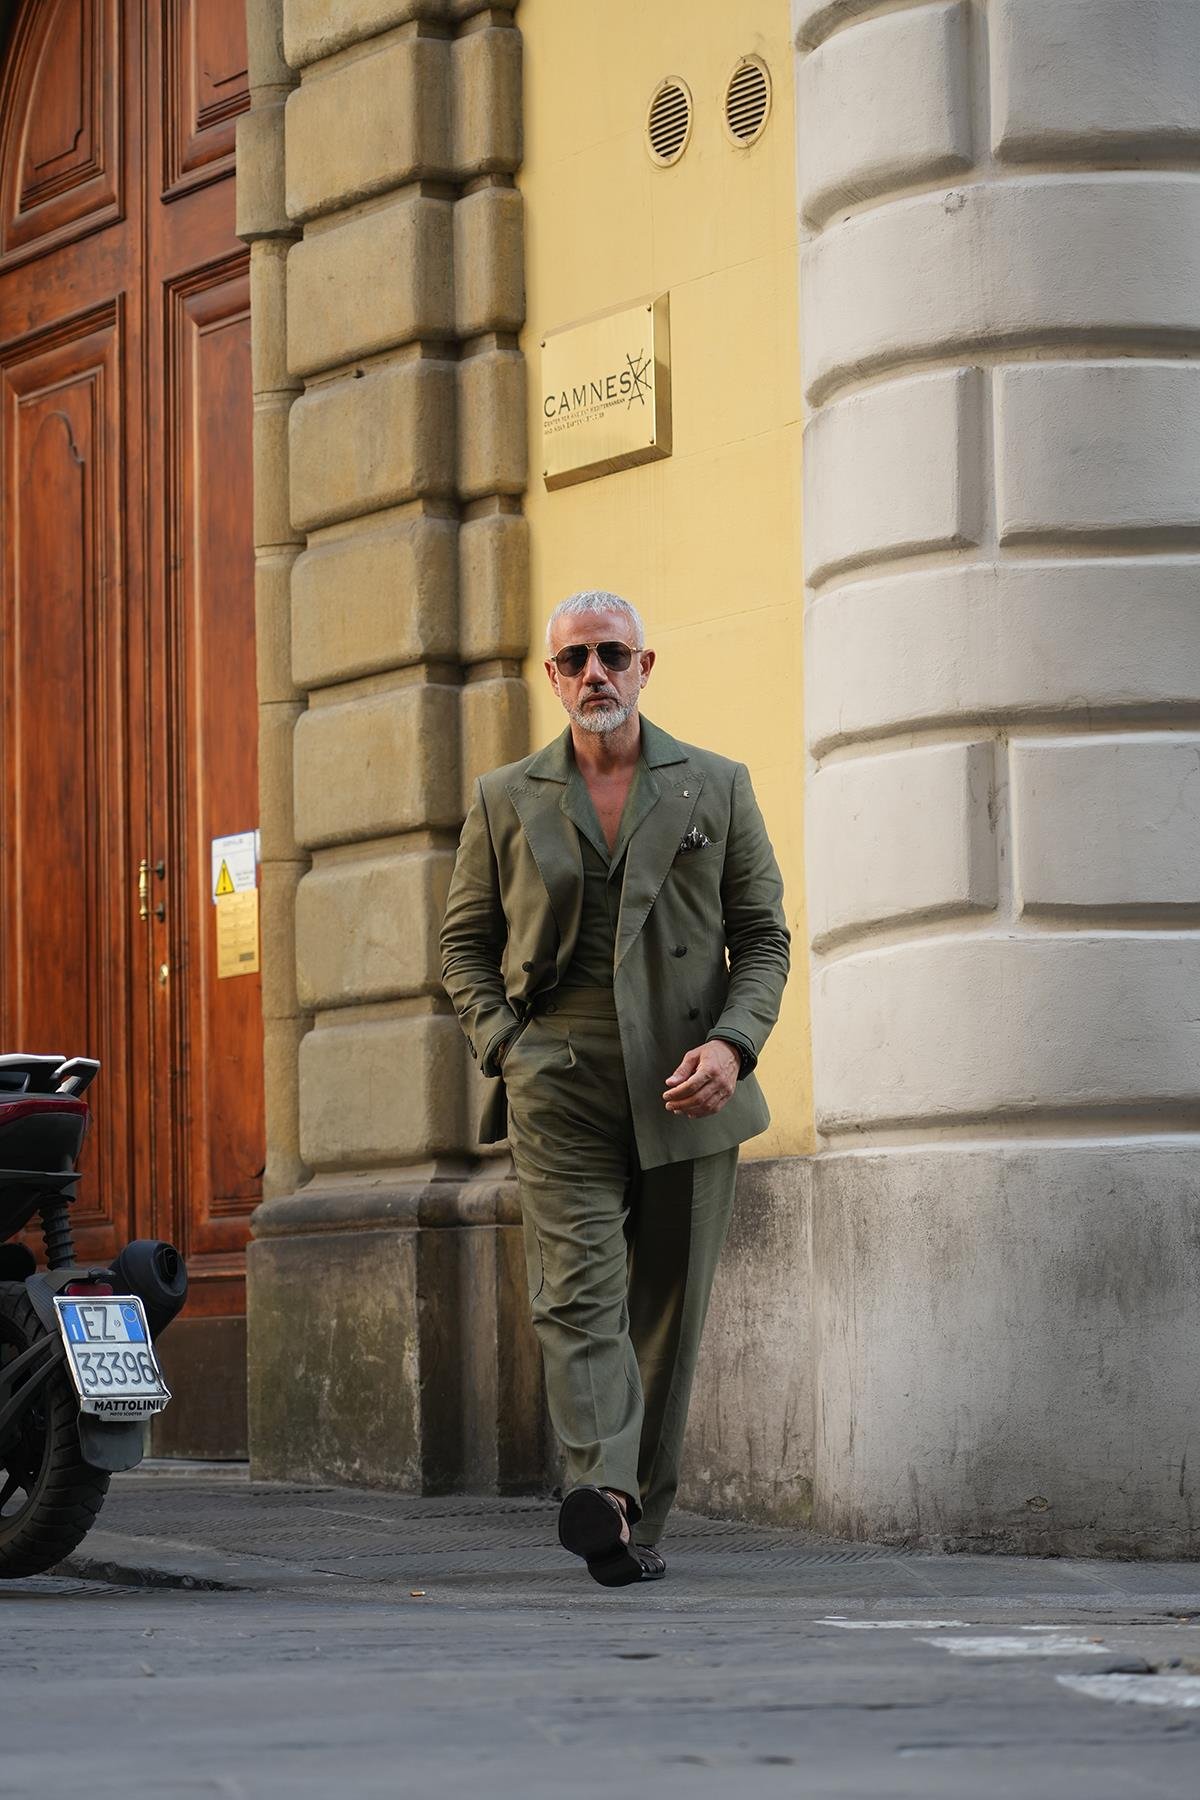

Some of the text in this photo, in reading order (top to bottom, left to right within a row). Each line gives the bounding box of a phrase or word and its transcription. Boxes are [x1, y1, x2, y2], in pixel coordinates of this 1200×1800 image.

[543, 371, 631, 418] CAMNES
[79, 1306, 116, 1340] EZ
[77, 1351, 156, 1387] 33396
[94, 1400, 159, 1411] MATTOLINI
